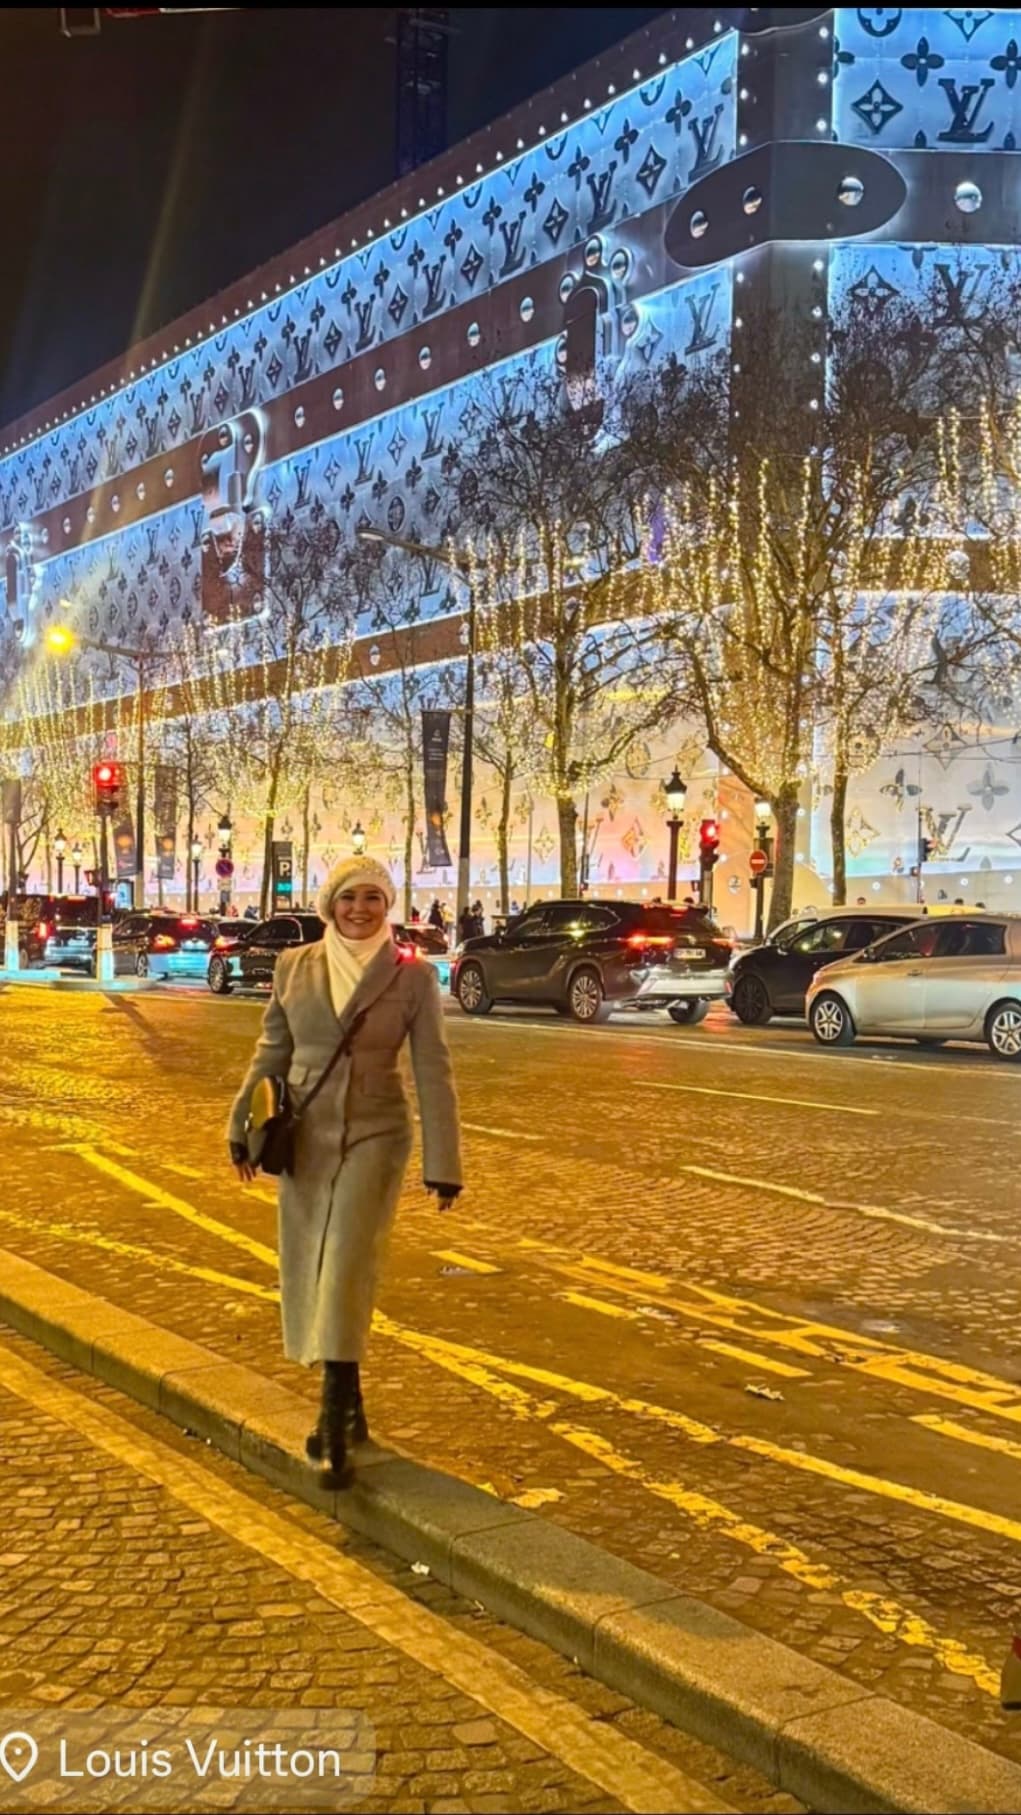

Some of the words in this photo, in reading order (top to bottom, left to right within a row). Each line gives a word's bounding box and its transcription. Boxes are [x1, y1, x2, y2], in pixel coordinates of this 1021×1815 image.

[938, 78, 995, 143] LV
[688, 103, 724, 184] LV
[586, 160, 618, 235] LV
[499, 210, 527, 278] LV
[422, 254, 447, 318] LV
[684, 283, 720, 356] LV
[354, 432, 375, 486] LV
[420, 402, 446, 461] LV
[293, 459, 313, 511] LV
